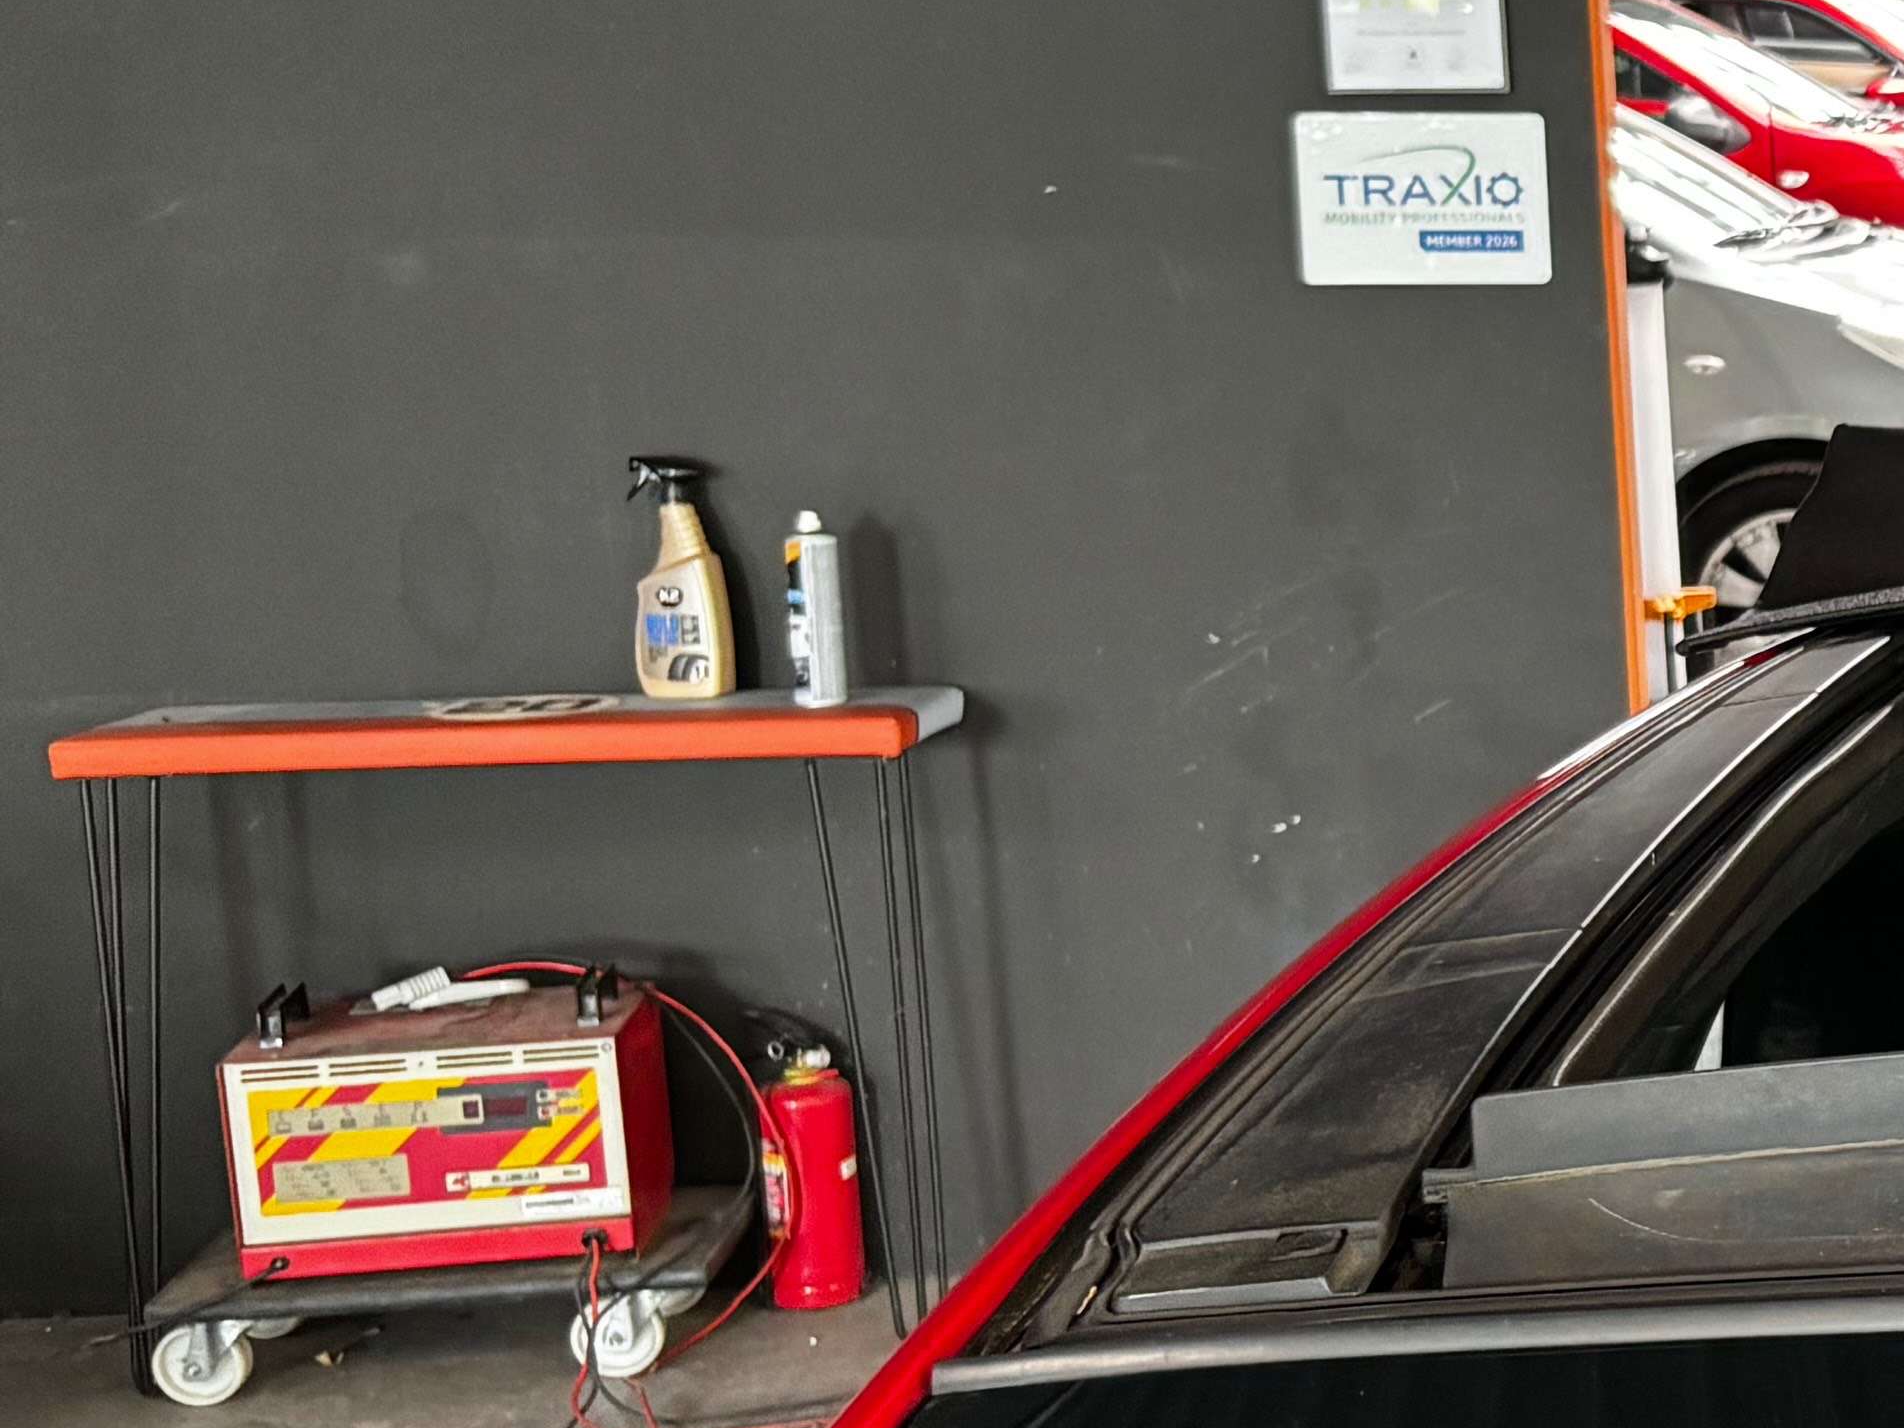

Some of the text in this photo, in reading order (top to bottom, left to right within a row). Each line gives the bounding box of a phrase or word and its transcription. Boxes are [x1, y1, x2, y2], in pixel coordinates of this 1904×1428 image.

[1323, 172, 1524, 207] TRAXIO
[1324, 210, 1526, 225] MOBILITY PROFESSIONALS
[1425, 235, 1482, 247] MEMBER
